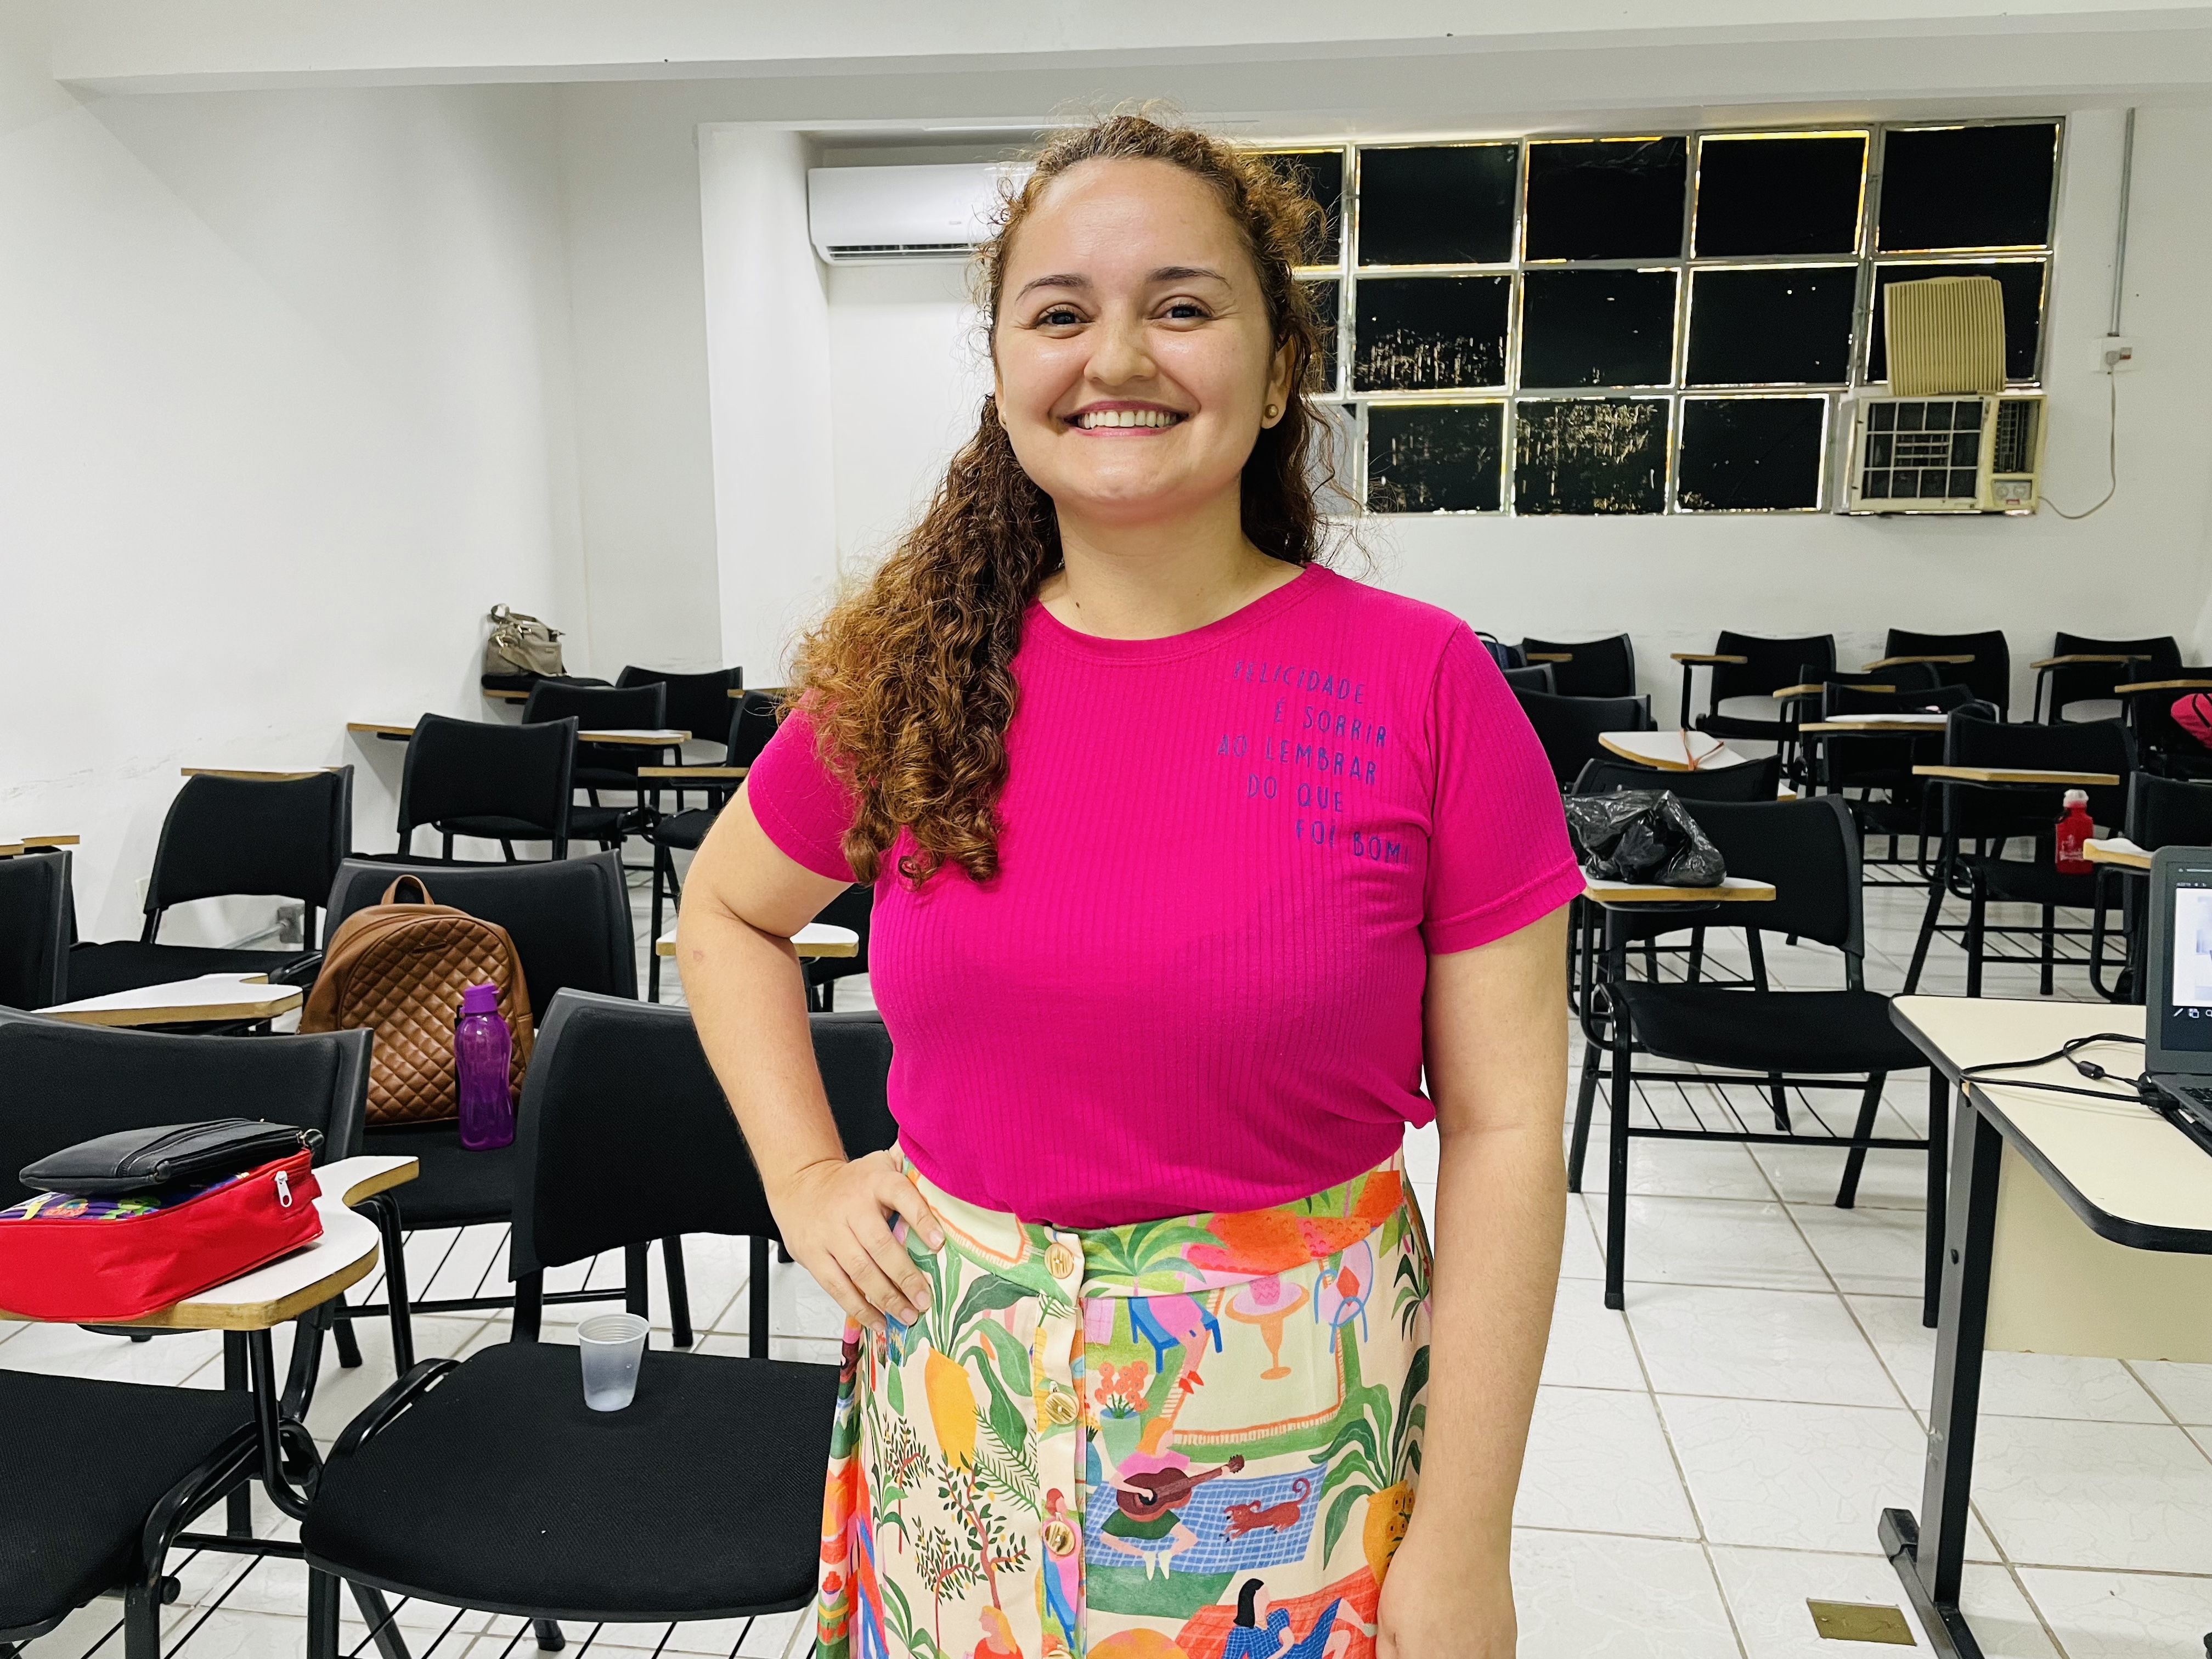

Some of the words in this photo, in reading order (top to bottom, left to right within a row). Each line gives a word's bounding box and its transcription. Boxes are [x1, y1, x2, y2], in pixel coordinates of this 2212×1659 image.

[1233, 661, 1365, 704] FELICIDADE
[1302, 706, 1386, 748] SORRIR
[1217, 734, 1247, 758] AO
[1266, 737, 1376, 785] LEMBRAR
[1247, 773, 1277, 799] DO
[1297, 783, 1344, 813] QUE
[1296, 819, 1336, 849] FOI
